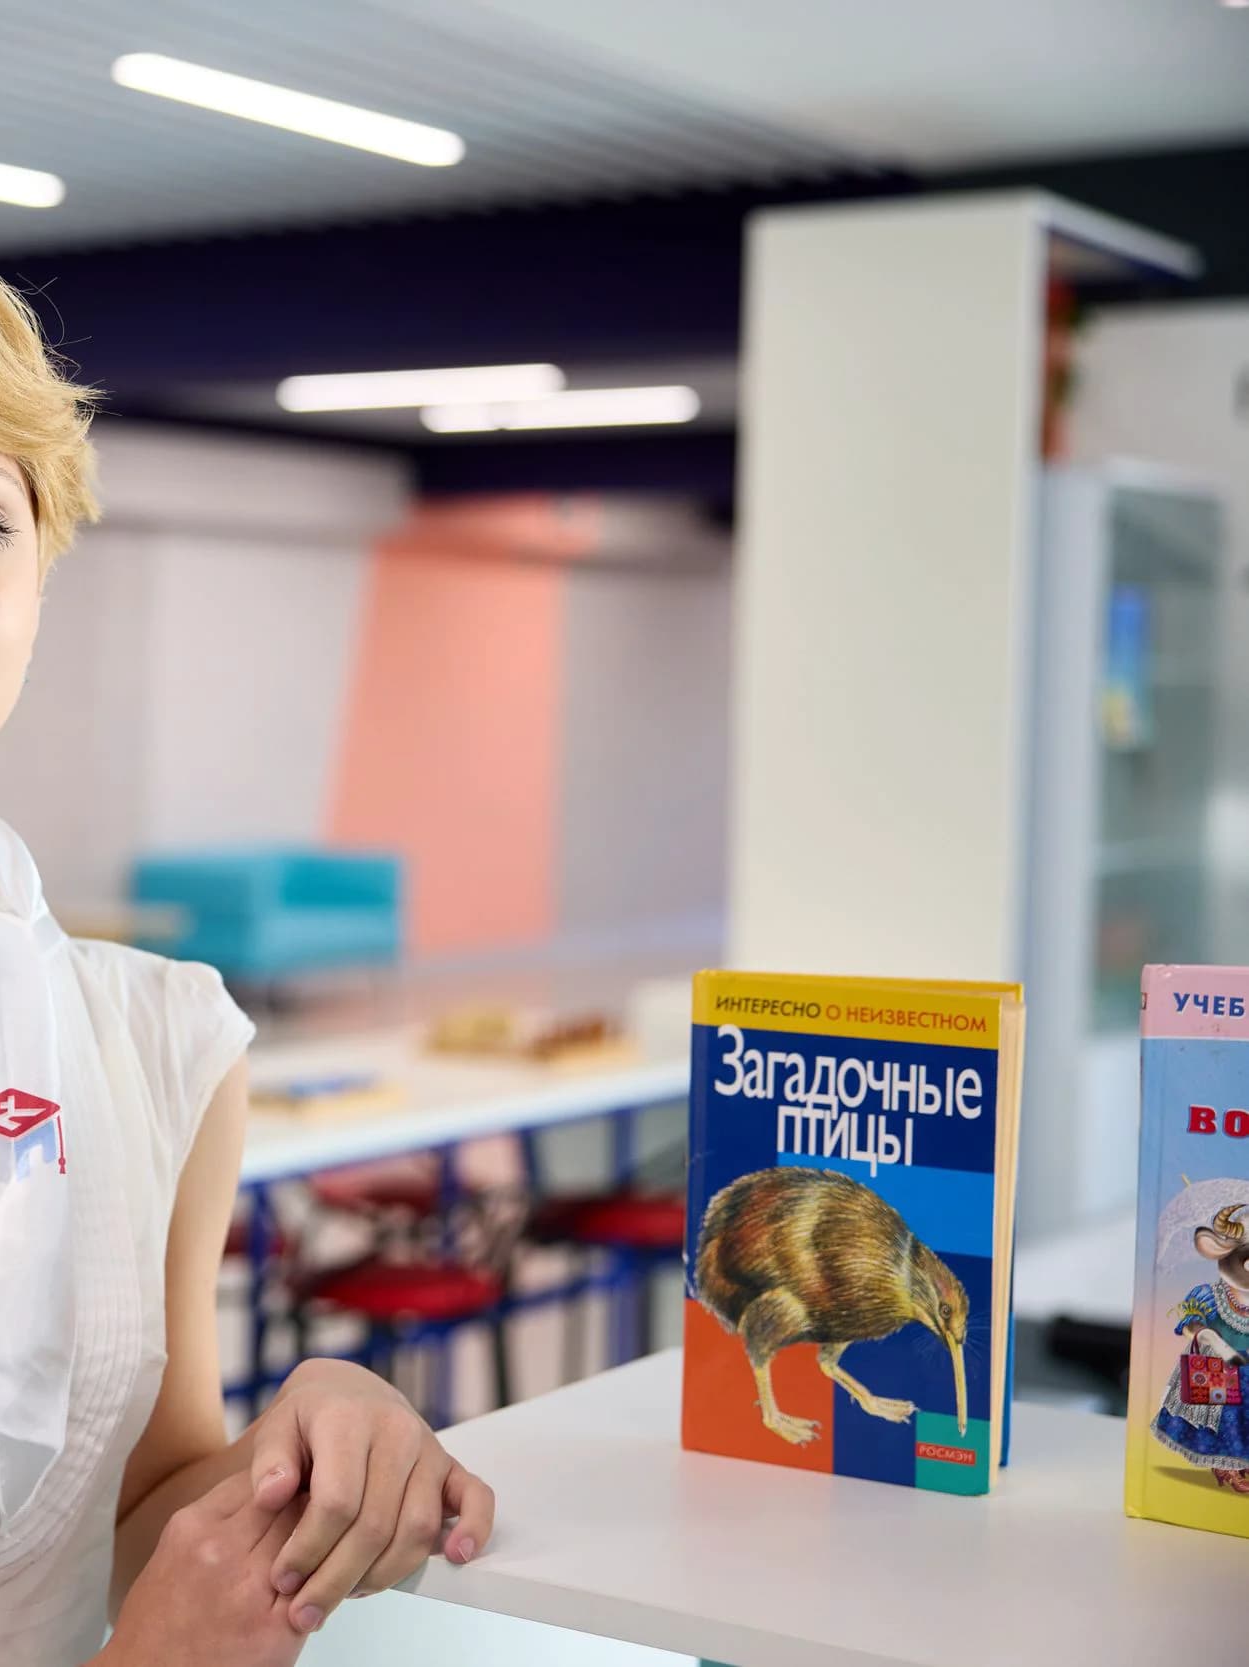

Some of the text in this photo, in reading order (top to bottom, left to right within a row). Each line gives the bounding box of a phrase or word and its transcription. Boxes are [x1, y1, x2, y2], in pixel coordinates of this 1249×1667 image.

[714, 996, 987, 1033] ИНТЕРЕСНО О НЕИЗВЕСТНОМ
[1173, 992, 1246, 1017] УЧЕБ
[713, 1023, 984, 1120] Загадочные
[776, 1105, 914, 1178] птицы
[918, 1445, 973, 1462] РОСМЭН
